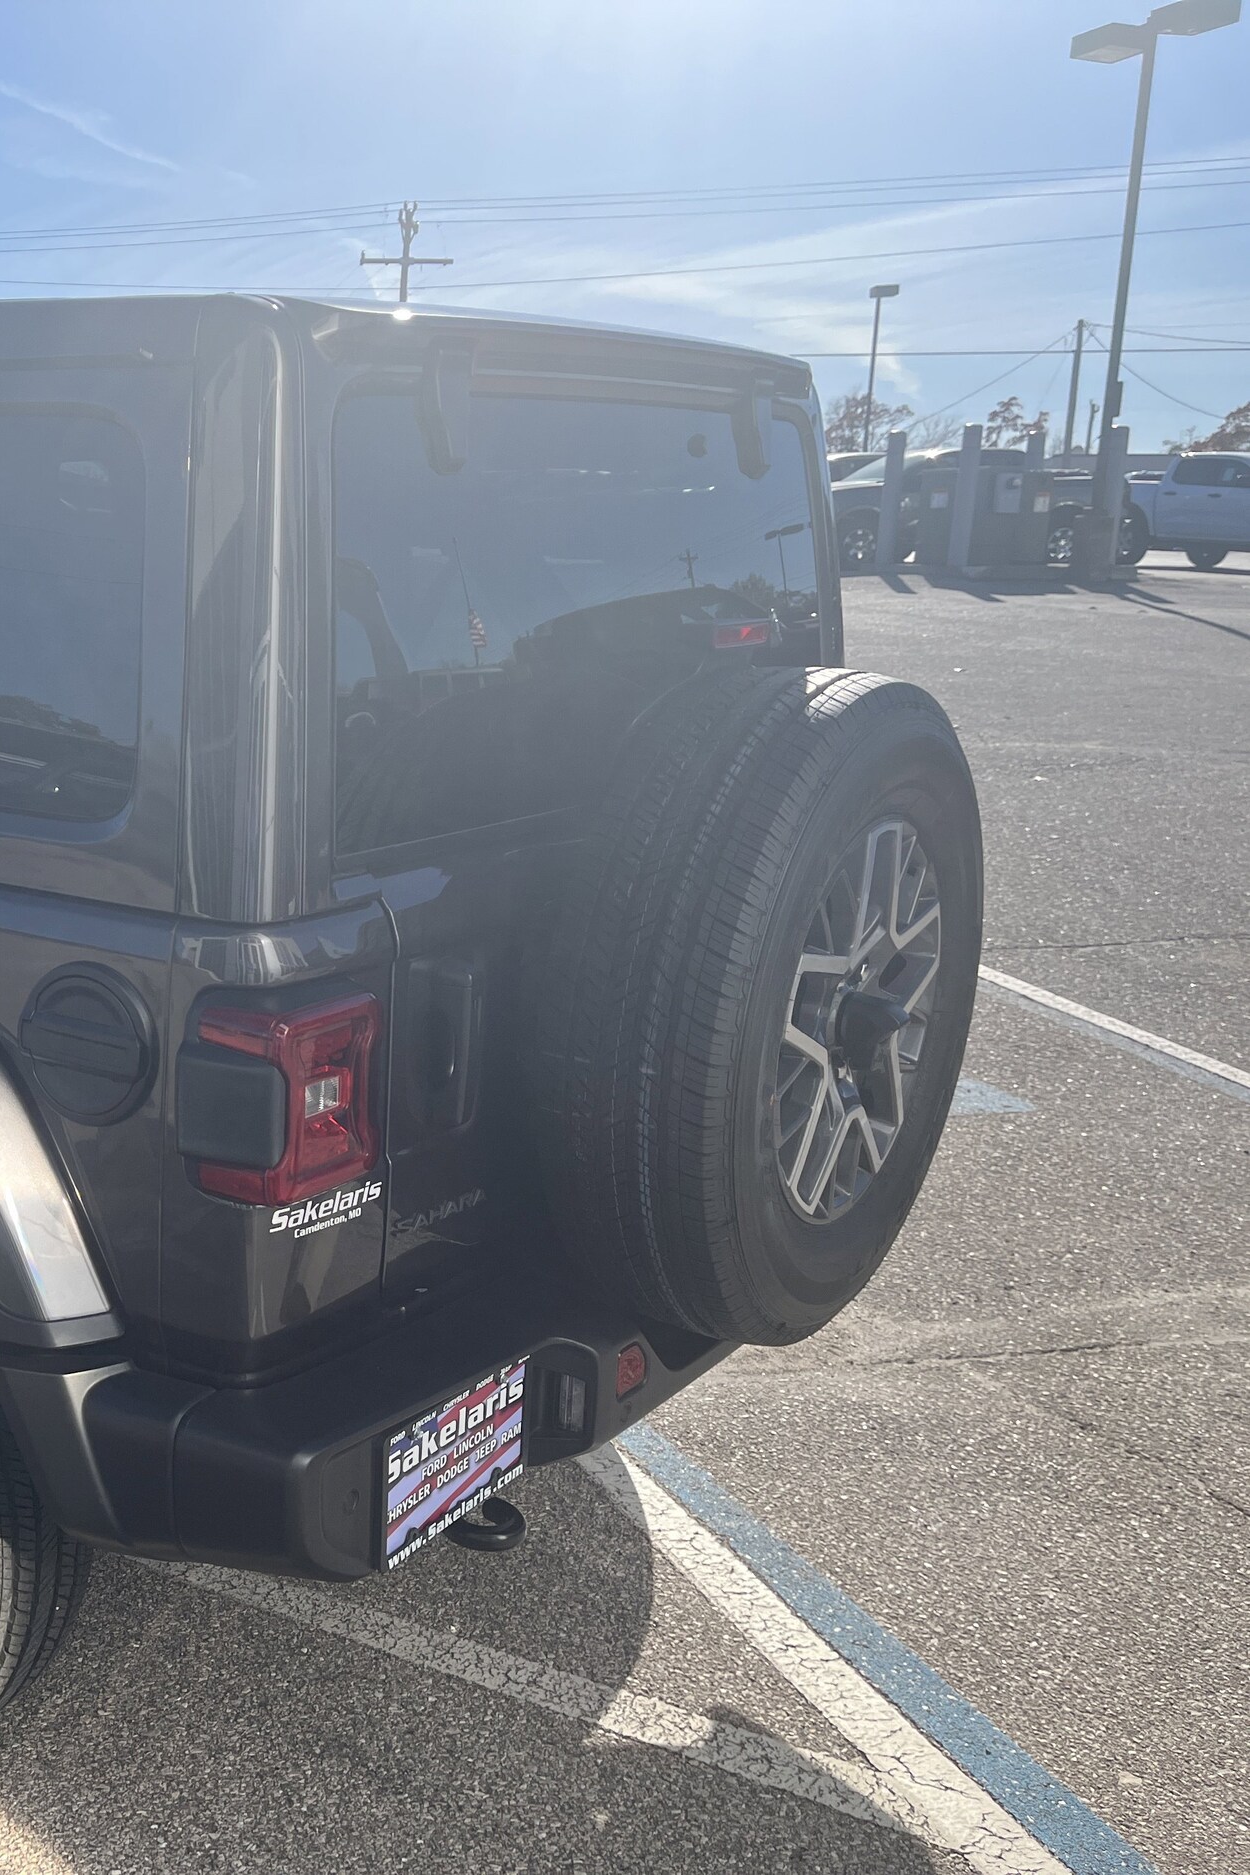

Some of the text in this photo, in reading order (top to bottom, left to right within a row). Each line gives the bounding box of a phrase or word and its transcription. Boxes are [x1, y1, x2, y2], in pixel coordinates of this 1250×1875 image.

[269, 1180, 383, 1233] Sakelaris
[294, 1207, 362, 1239] Camdenton, MO
[391, 1187, 487, 1233] SAHARA
[388, 1377, 524, 1484] Sakelaris
[389, 1430, 406, 1447] FORD
[411, 1410, 437, 1431] LINCOLN
[443, 1389, 470, 1412] CHRYSLER
[476, 1374, 494, 1391] DODGE
[421, 1423, 494, 1481] FORD LINCOLN
[436, 1459, 469, 1489] DODGE
[474, 1439, 497, 1464] JEEP
[500, 1421, 522, 1448] RAM
[387, 1463, 524, 1570] www.Sakelaris.com
